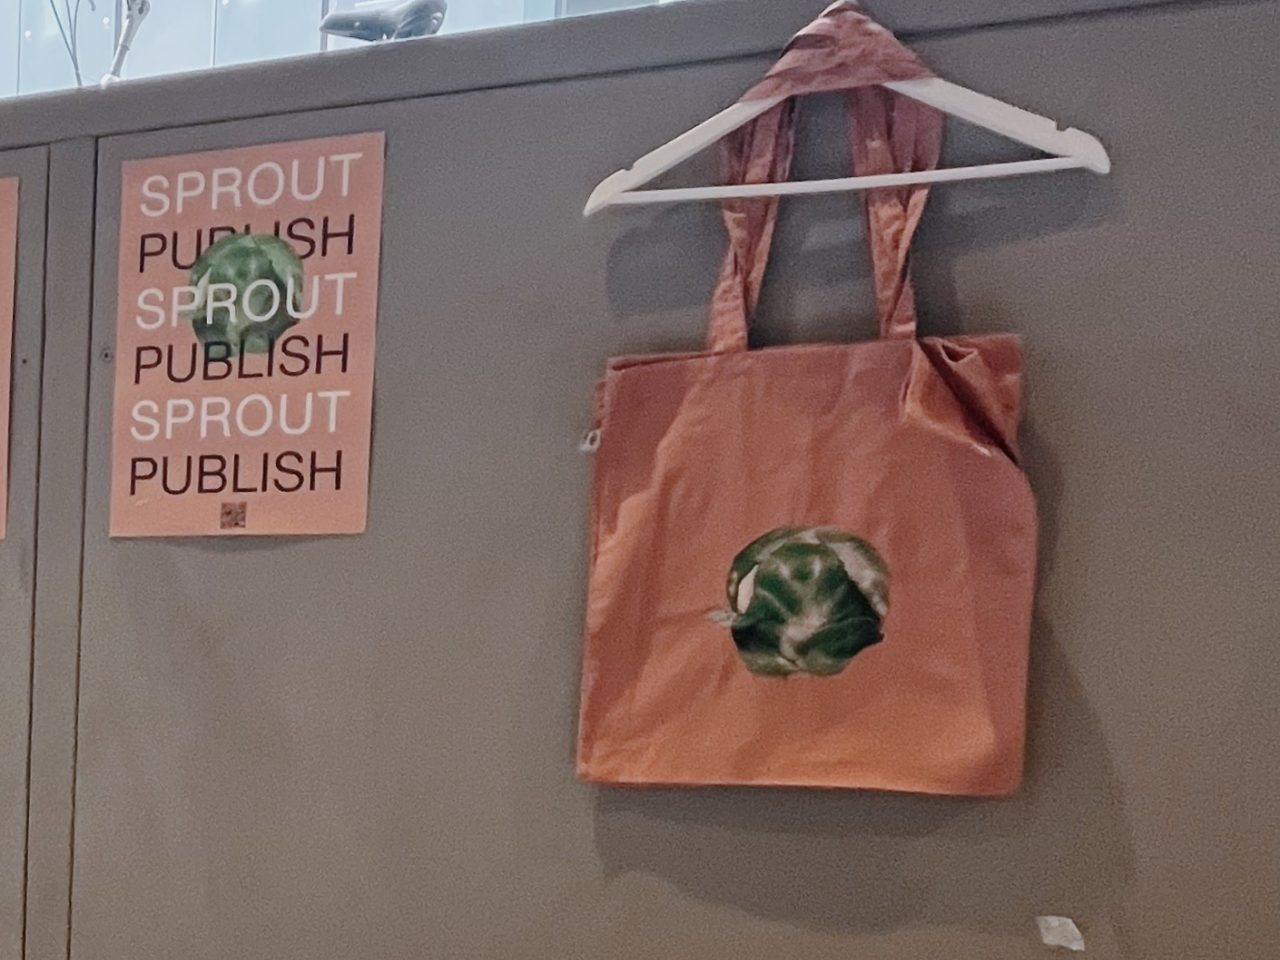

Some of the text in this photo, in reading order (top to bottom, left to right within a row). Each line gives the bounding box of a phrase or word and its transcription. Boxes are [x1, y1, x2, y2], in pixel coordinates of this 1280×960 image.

[140, 153, 363, 217] SPROUT
[139, 214, 355, 273] PUSH
[136, 272, 358, 329] SPROUT
[134, 333, 350, 385] PUBLISH
[130, 390, 351, 442] SPROUT
[130, 450, 343, 495] PUBLISH
